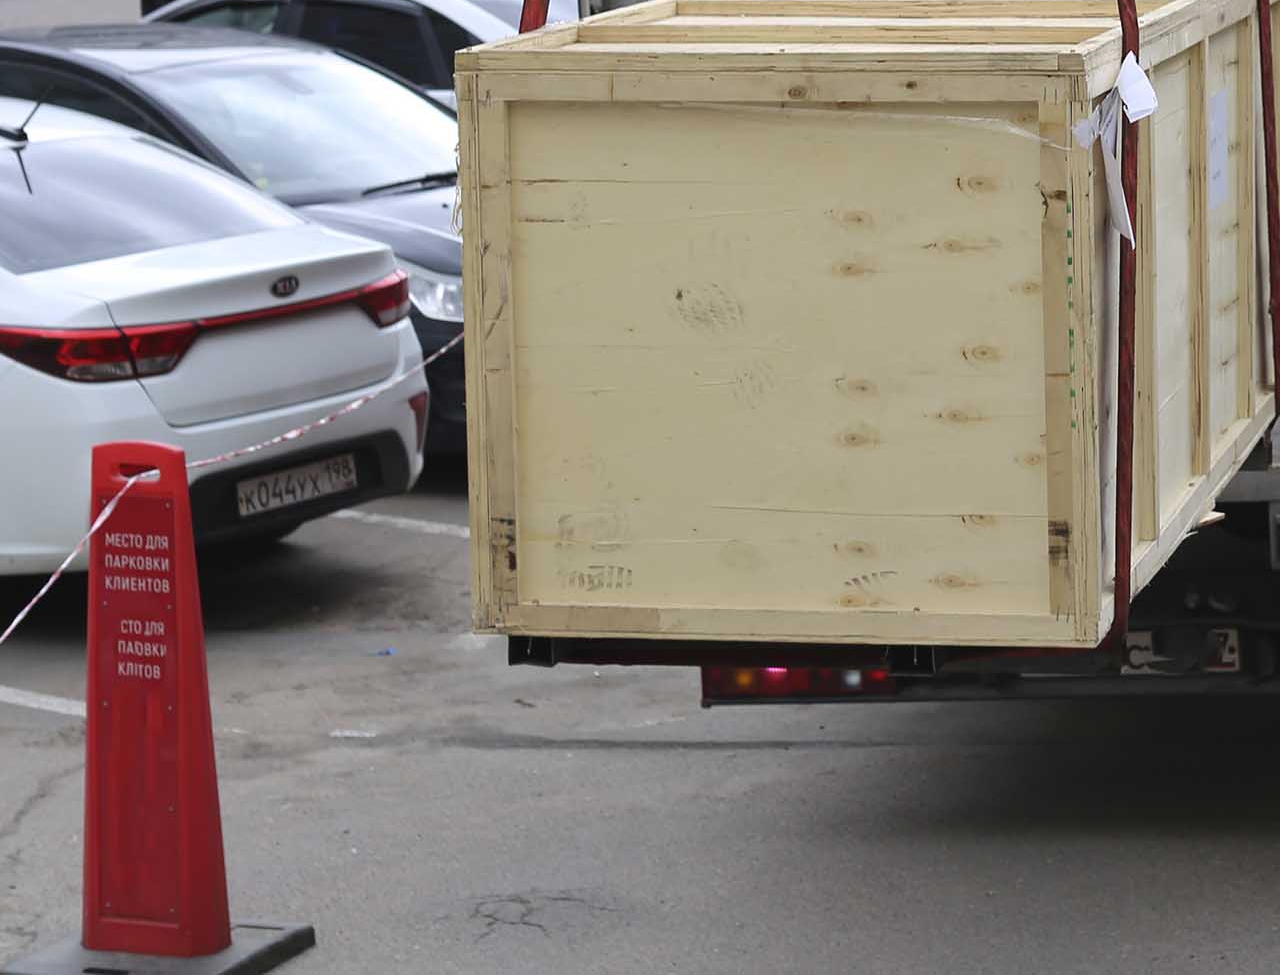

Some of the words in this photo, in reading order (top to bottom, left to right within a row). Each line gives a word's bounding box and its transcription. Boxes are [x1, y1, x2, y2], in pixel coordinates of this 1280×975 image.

[105, 533, 143, 549] МЕСТО
[145, 534, 169, 550] ДЛЯ
[105, 554, 170, 571] ПАРКОВКИ
[105, 576, 170, 593] КЛИЕНТОВ
[120, 619, 142, 634] СТО
